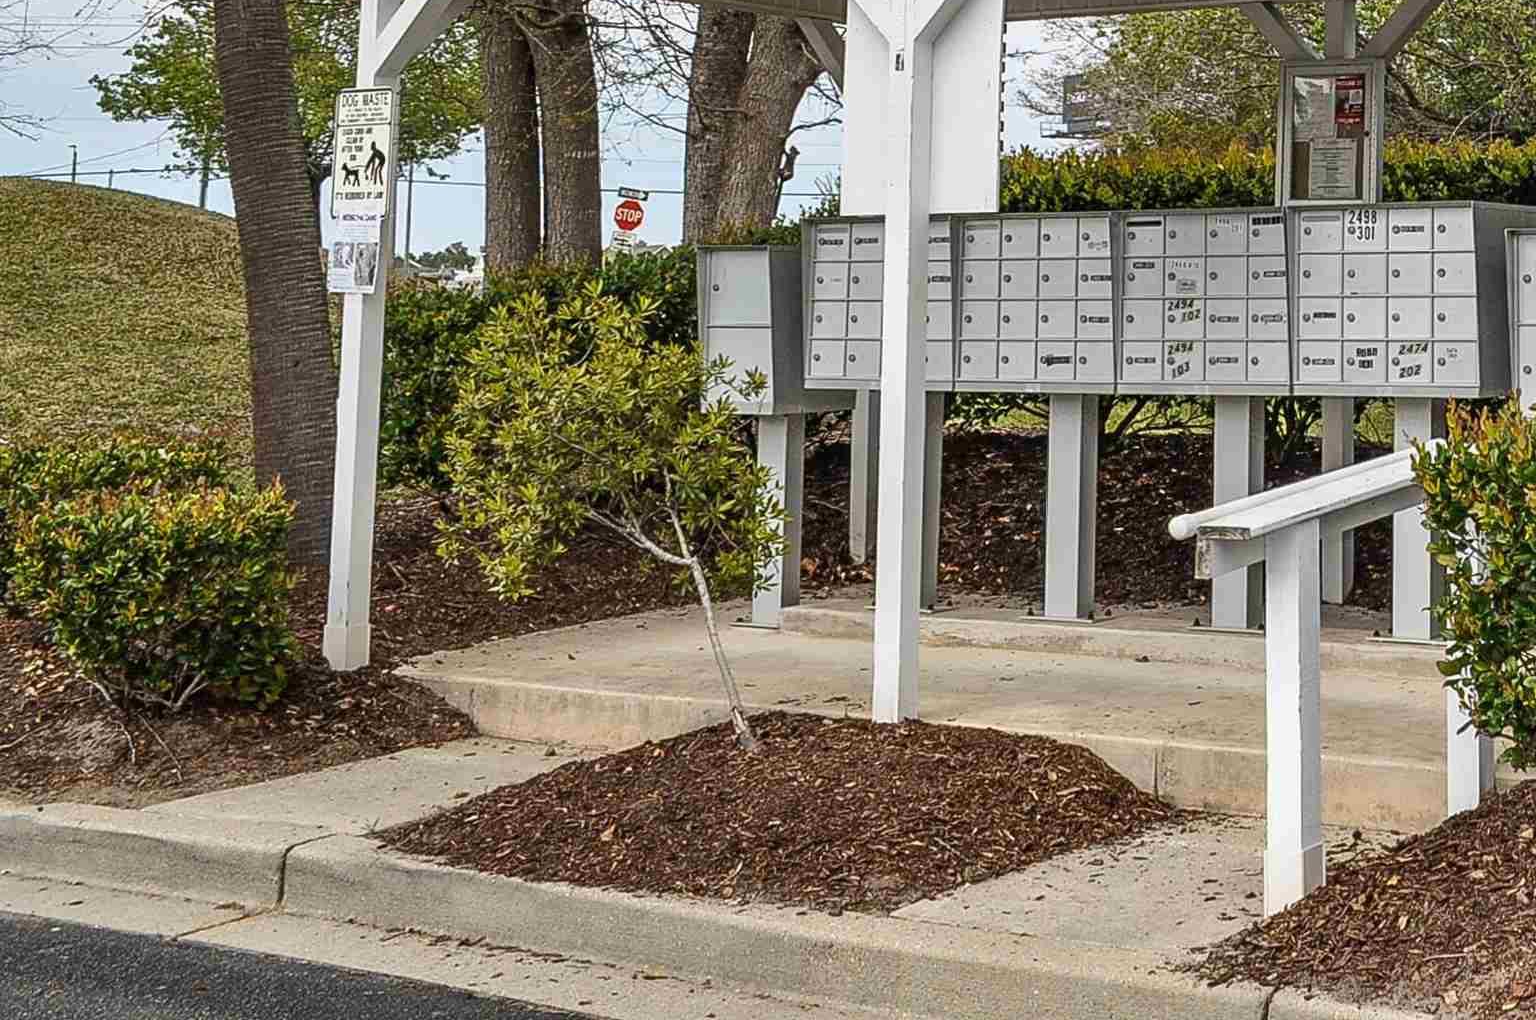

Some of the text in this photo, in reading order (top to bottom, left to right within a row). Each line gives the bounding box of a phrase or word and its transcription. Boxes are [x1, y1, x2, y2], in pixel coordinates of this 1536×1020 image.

[342, 92, 389, 107] DOG WASTE
[615, 208, 642, 223] STOP
[1349, 210, 1377, 225] 2498
[1357, 226, 1375, 240] 301
[1167, 300, 1194, 311] 2494
[1182, 309, 1201, 322] 102
[1167, 343, 1194, 355] 2494
[1171, 362, 1190, 379] 103
[1399, 365, 1422, 378] 202
